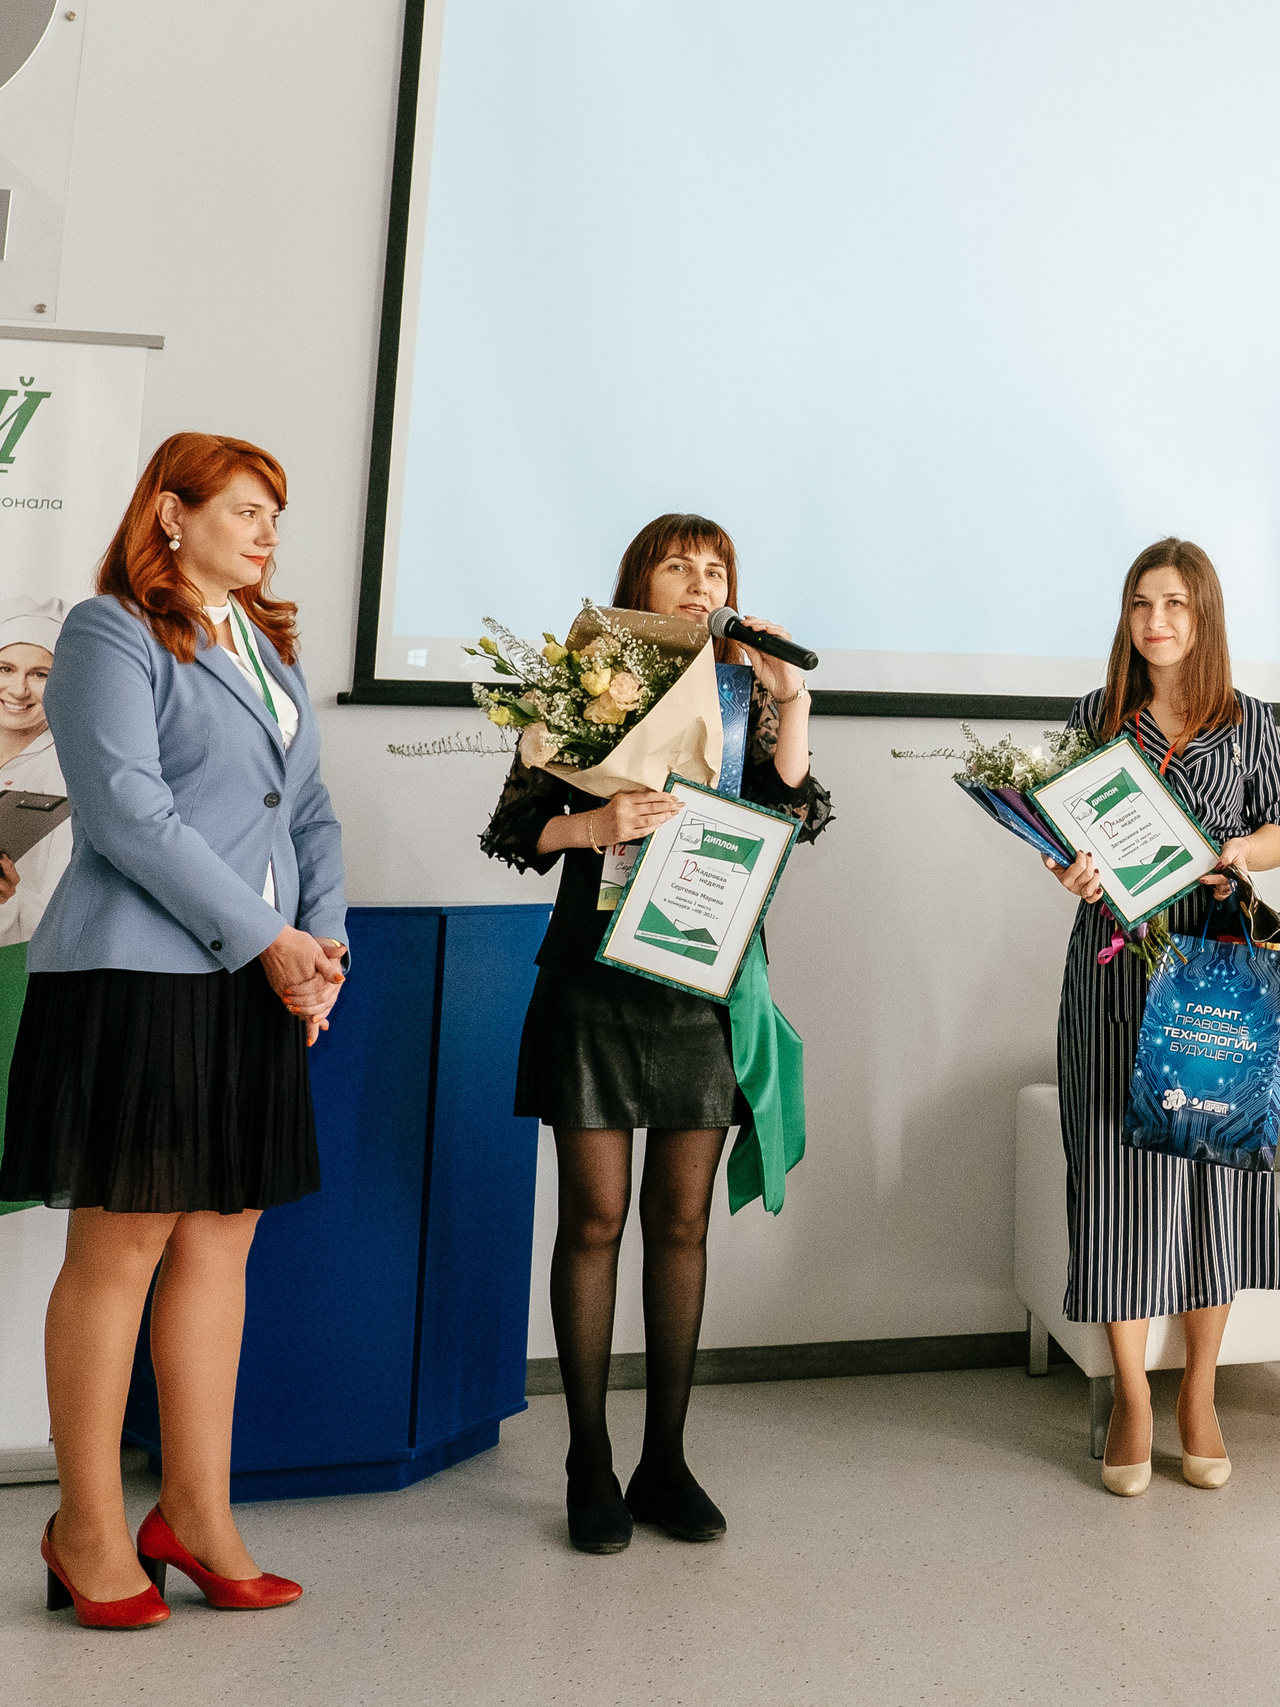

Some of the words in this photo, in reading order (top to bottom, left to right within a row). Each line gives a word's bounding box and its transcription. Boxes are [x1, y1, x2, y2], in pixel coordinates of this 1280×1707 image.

[0, 497, 63, 510] онала
[1090, 786, 1119, 807] ДИПЛОМ
[1099, 820, 1119, 840] 12
[703, 834, 739, 853] ДИПЛОМ
[678, 858, 698, 883] 12
[1185, 1002, 1243, 1022] ГАРАНТ.
[1175, 1014, 1250, 1036] ПРАВОВЫЕ
[1162, 1026, 1258, 1052] ТЕХНОЛОГИИ
[1169, 1041, 1244, 1064] БУДУЩЕГО
